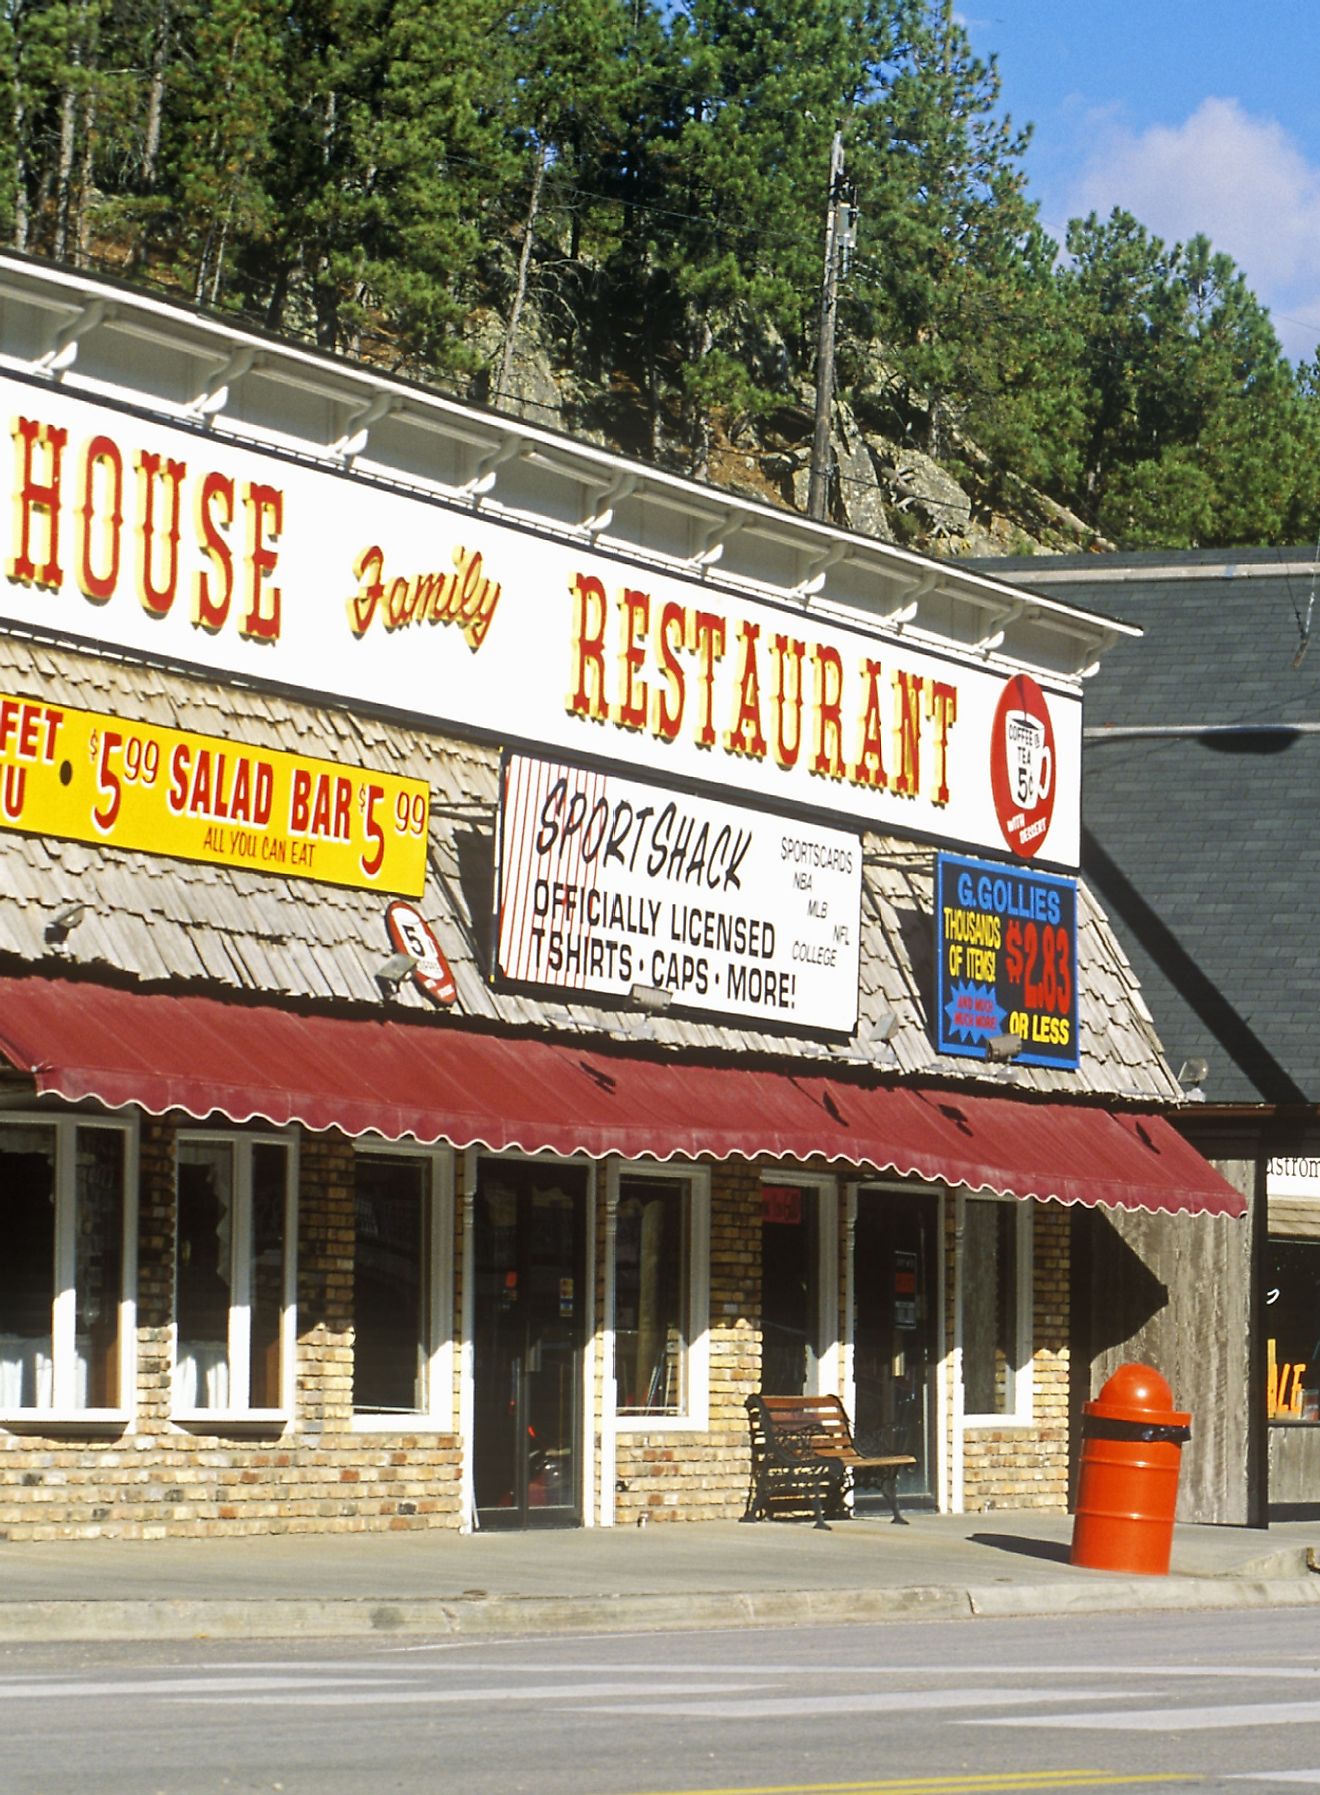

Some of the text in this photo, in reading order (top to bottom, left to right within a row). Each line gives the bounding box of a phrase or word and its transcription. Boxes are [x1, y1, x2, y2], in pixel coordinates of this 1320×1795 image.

[6, 415, 957, 808] HOUSE Family RESTAURANT
[1009, 724, 1032, 747] COFFEE
[1017, 747, 1031, 765] TEA
[169, 743, 273, 830] SALAD
[288, 769, 351, 842] BAR
[203, 826, 316, 868] ALL YOU CAN EAT
[781, 836, 853, 874] SPORTSCARDS
[793, 872, 813, 891] NBA
[533, 879, 775, 960] OFFICIALLY LICENSED
[807, 899, 828, 920] MLB
[833, 924, 850, 946] NFL
[944, 907, 1001, 950] THOUSANDS
[531, 927, 796, 1009] TSHIRTS CAPS MORE!
[791, 940, 837, 968] COLLEGE
[949, 944, 963, 977] OF
[1009, 1011, 1070, 1046] OR LESS
